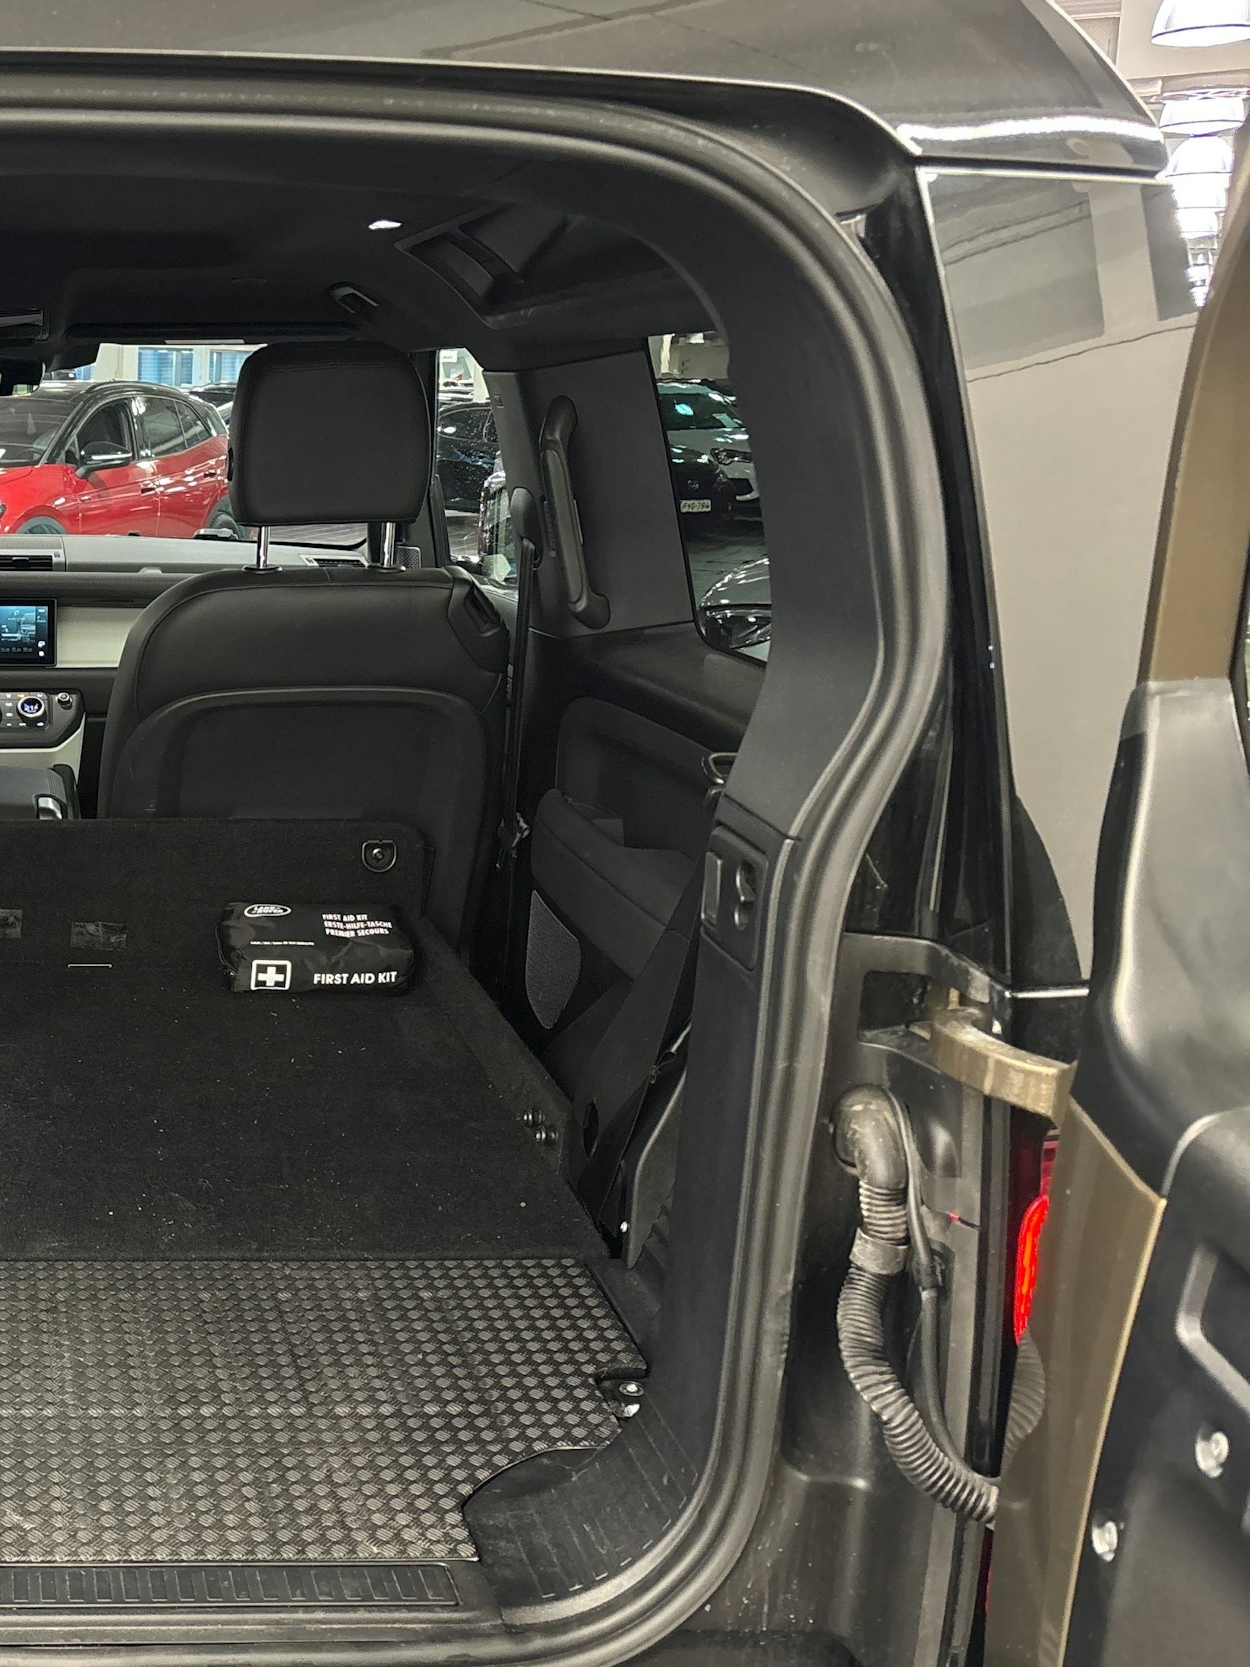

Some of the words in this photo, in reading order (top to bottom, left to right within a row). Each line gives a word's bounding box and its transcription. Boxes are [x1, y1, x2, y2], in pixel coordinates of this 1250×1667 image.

[324, 921, 392, 929] ERSTE-HILFE-TASCHE
[325, 928, 355, 938] PREMIER
[357, 928, 389, 936] SECOURS
[313, 973, 349, 984] FIRST
[350, 973, 375, 984] AID
[377, 971, 397, 984] KIT
